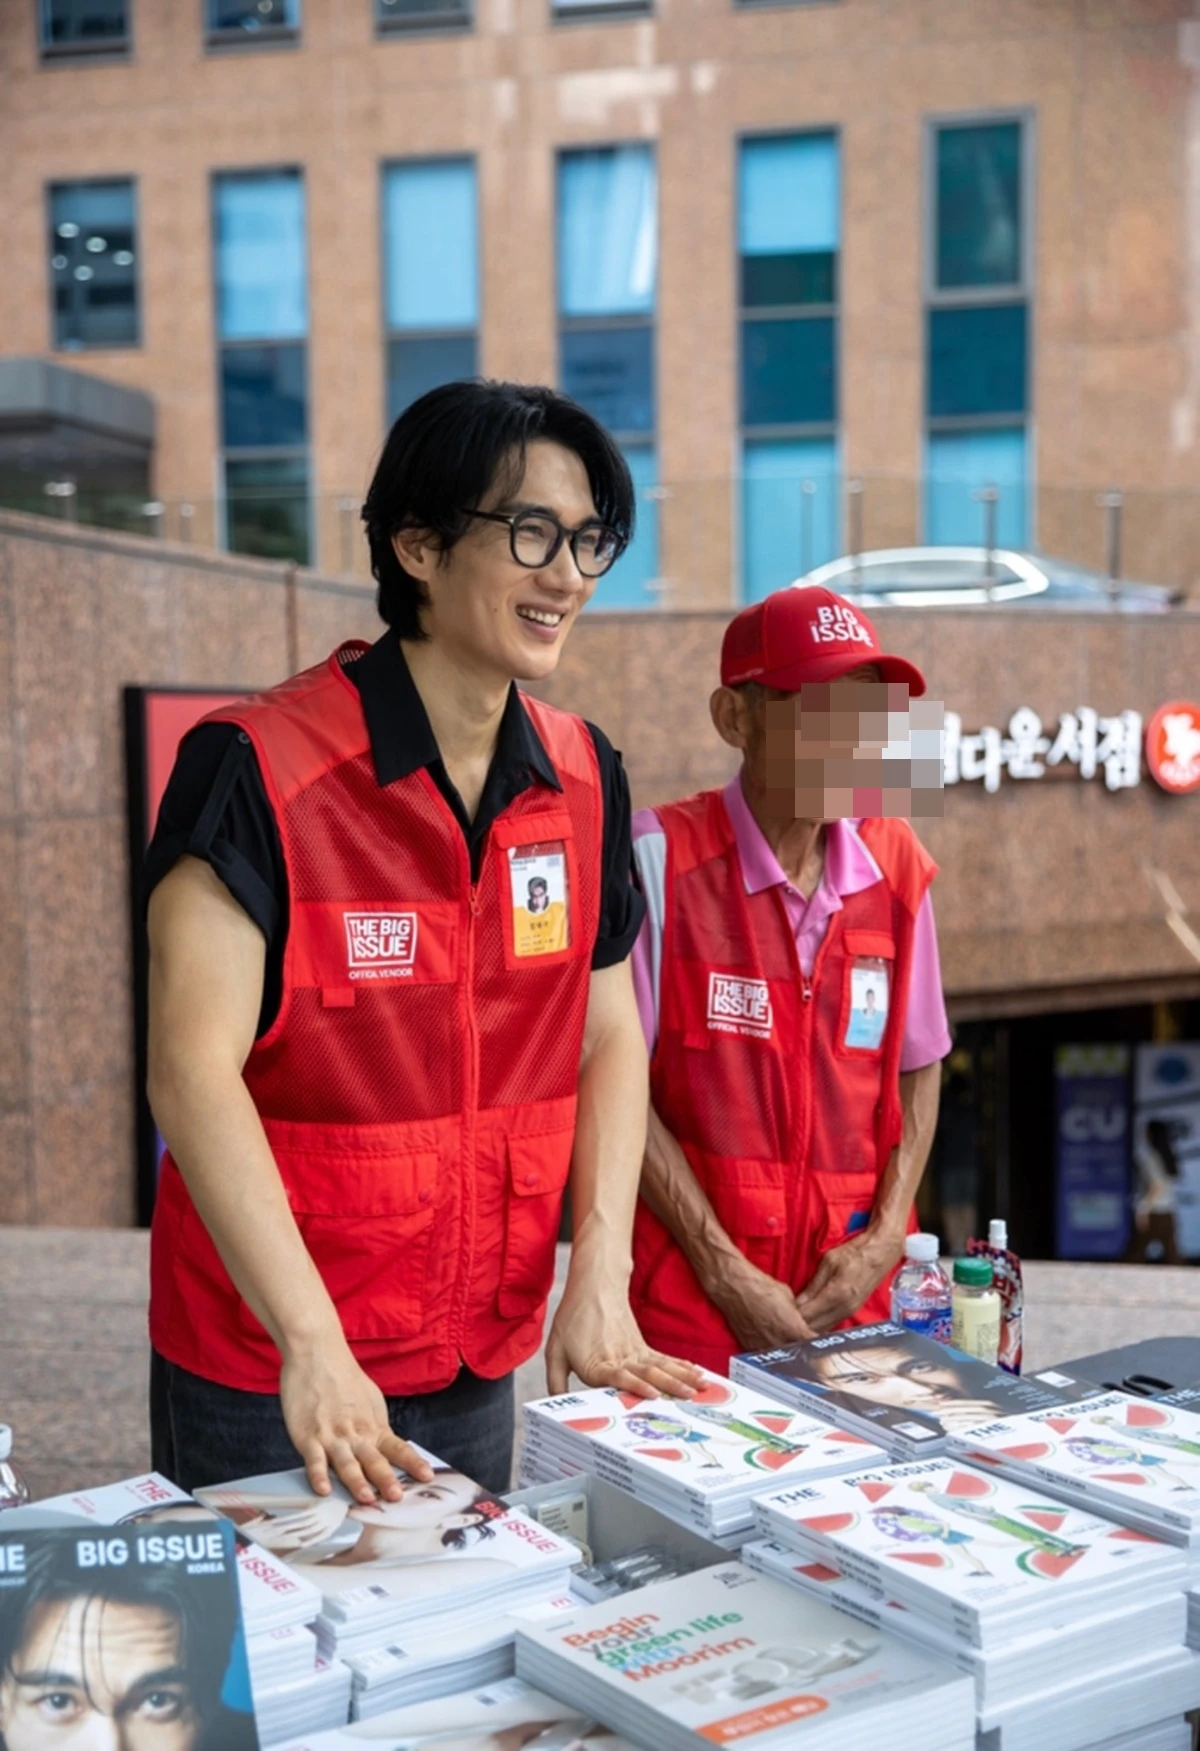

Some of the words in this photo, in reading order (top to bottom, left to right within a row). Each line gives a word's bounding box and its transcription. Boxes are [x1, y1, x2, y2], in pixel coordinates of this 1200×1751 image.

[817, 604, 858, 625] BIG
[349, 919, 379, 936] THE
[380, 919, 410, 936] BIG
[352, 935, 410, 959] ISSUE
[378, 967, 414, 978] VENDOR
[714, 994, 767, 1019] ISSUE
[716, 980, 743, 998] THE
[744, 985, 769, 1001] BIG
[1060, 1102, 1127, 1141] CU
[748, 1349, 790, 1364] THE
[811, 1335, 846, 1349] BIG
[845, 1323, 900, 1340] ISSUE
[539, 1395, 585, 1409] THE
[964, 1422, 1012, 1438] THE
[1068, 1395, 1123, 1416] ISSUE
[769, 1487, 822, 1505] THE
[883, 1459, 949, 1479] ISSUE
[77, 1538, 129, 1568] BIG
[137, 1533, 225, 1563] ISSUE
[502, 1519, 559, 1553] ISSUE
[187, 1563, 225, 1575] KOREA
[240, 1557, 295, 1592] ISSUE
[561, 1612, 661, 1648] Begin
[580, 1625, 655, 1656] your
[595, 1628, 695, 1669] green
[689, 1611, 744, 1634] life
[612, 1644, 688, 1672] with
[622, 1636, 757, 1683] Moorim
